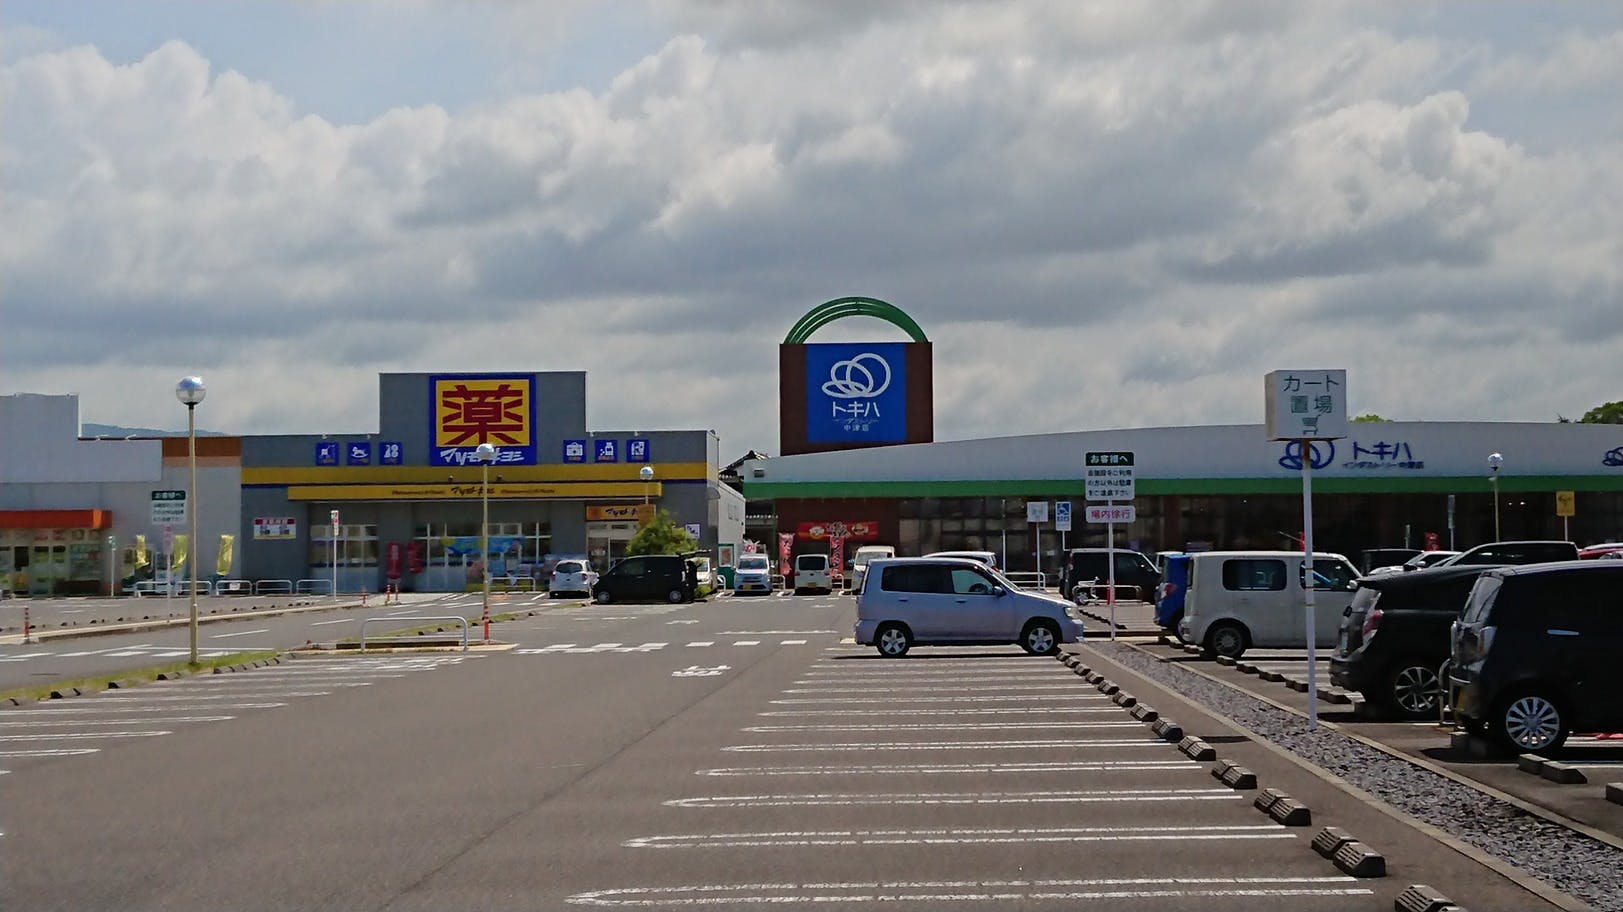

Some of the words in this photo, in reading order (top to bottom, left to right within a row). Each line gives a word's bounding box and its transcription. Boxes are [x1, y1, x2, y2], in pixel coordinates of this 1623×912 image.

[1283, 374, 1339, 392] カート
[832, 401, 880, 417] トキハ
[1291, 395, 1333, 413] 置場
[442, 384, 523, 445] 薬
[1353, 441, 1413, 460] トキハ
